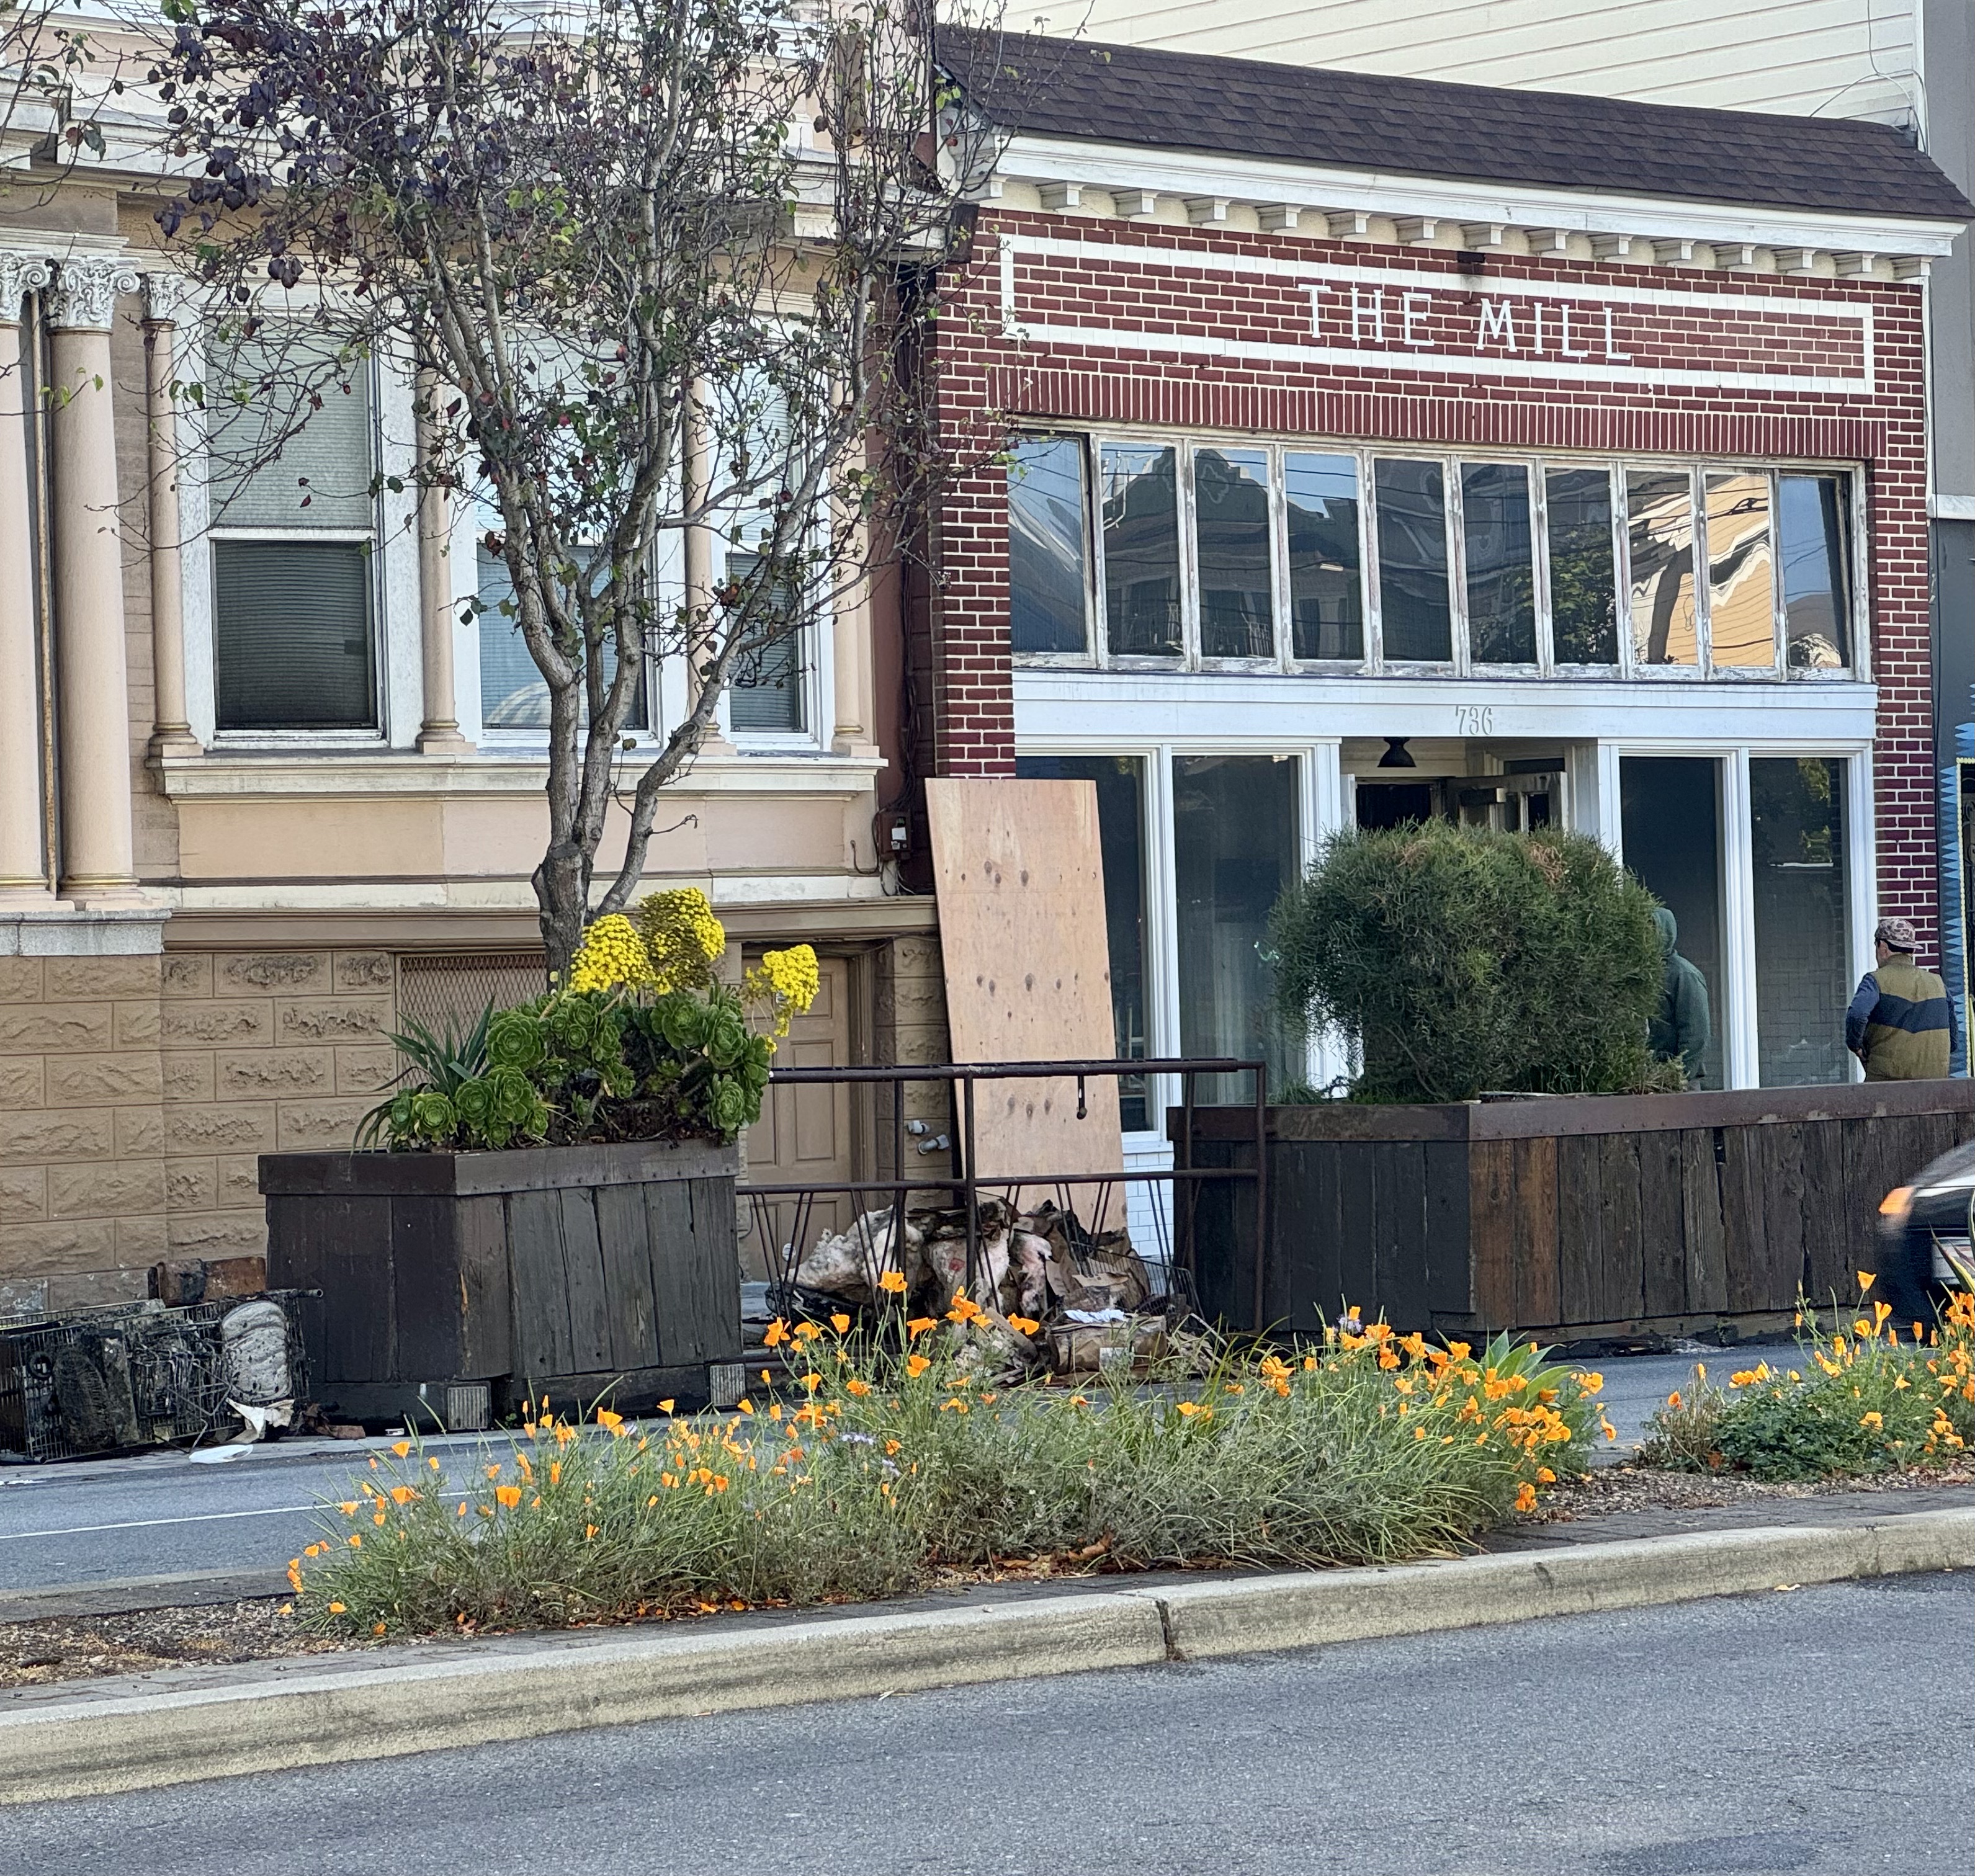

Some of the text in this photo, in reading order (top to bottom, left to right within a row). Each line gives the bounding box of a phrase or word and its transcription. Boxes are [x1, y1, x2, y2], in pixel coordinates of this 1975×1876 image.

[1298, 284, 1631, 360] THE MILL
[1455, 705, 1492, 735] 736
